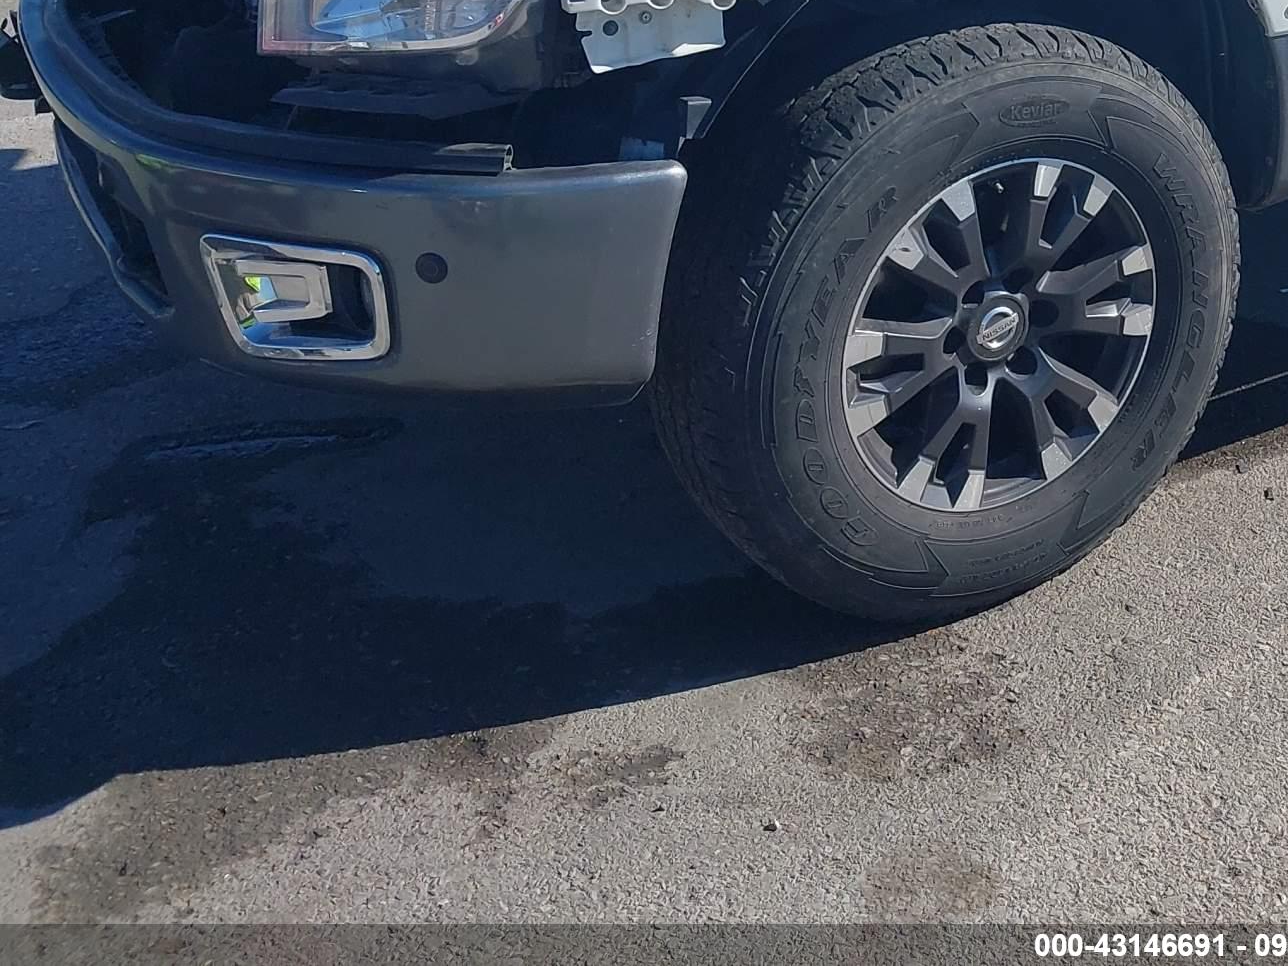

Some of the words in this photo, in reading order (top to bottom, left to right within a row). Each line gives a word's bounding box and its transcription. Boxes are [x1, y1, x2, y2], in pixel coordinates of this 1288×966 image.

[795, 185, 899, 546] GOODYEAR
[982, 316, 1017, 340] NISSAN
[1131, 153, 1207, 471] WRANGLER
